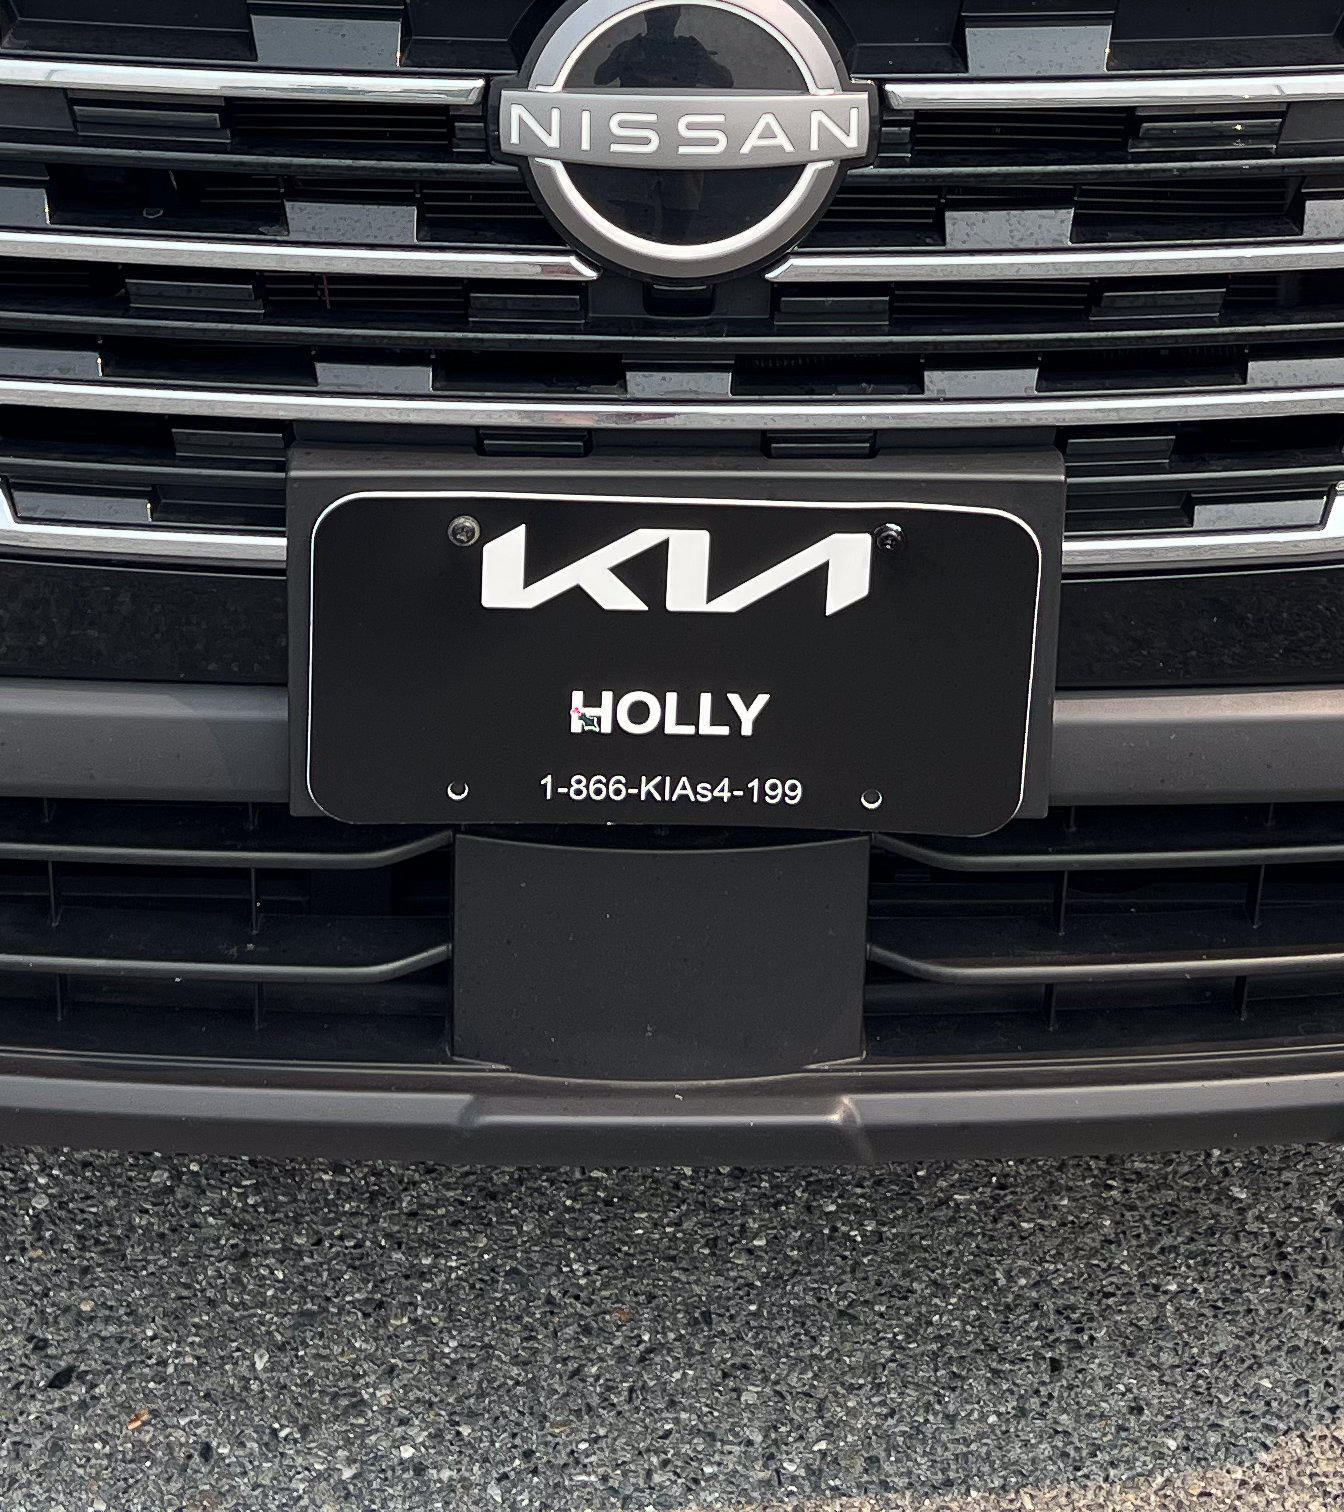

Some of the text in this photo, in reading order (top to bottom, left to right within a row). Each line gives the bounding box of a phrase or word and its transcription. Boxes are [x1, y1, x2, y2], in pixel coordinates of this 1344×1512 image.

[509, 102, 859, 155] NISSAN
[481, 524, 872, 617] KIA
[570, 690, 770, 736] HOLLY
[540, 774, 802, 804] 1-866-KIAs4-199
